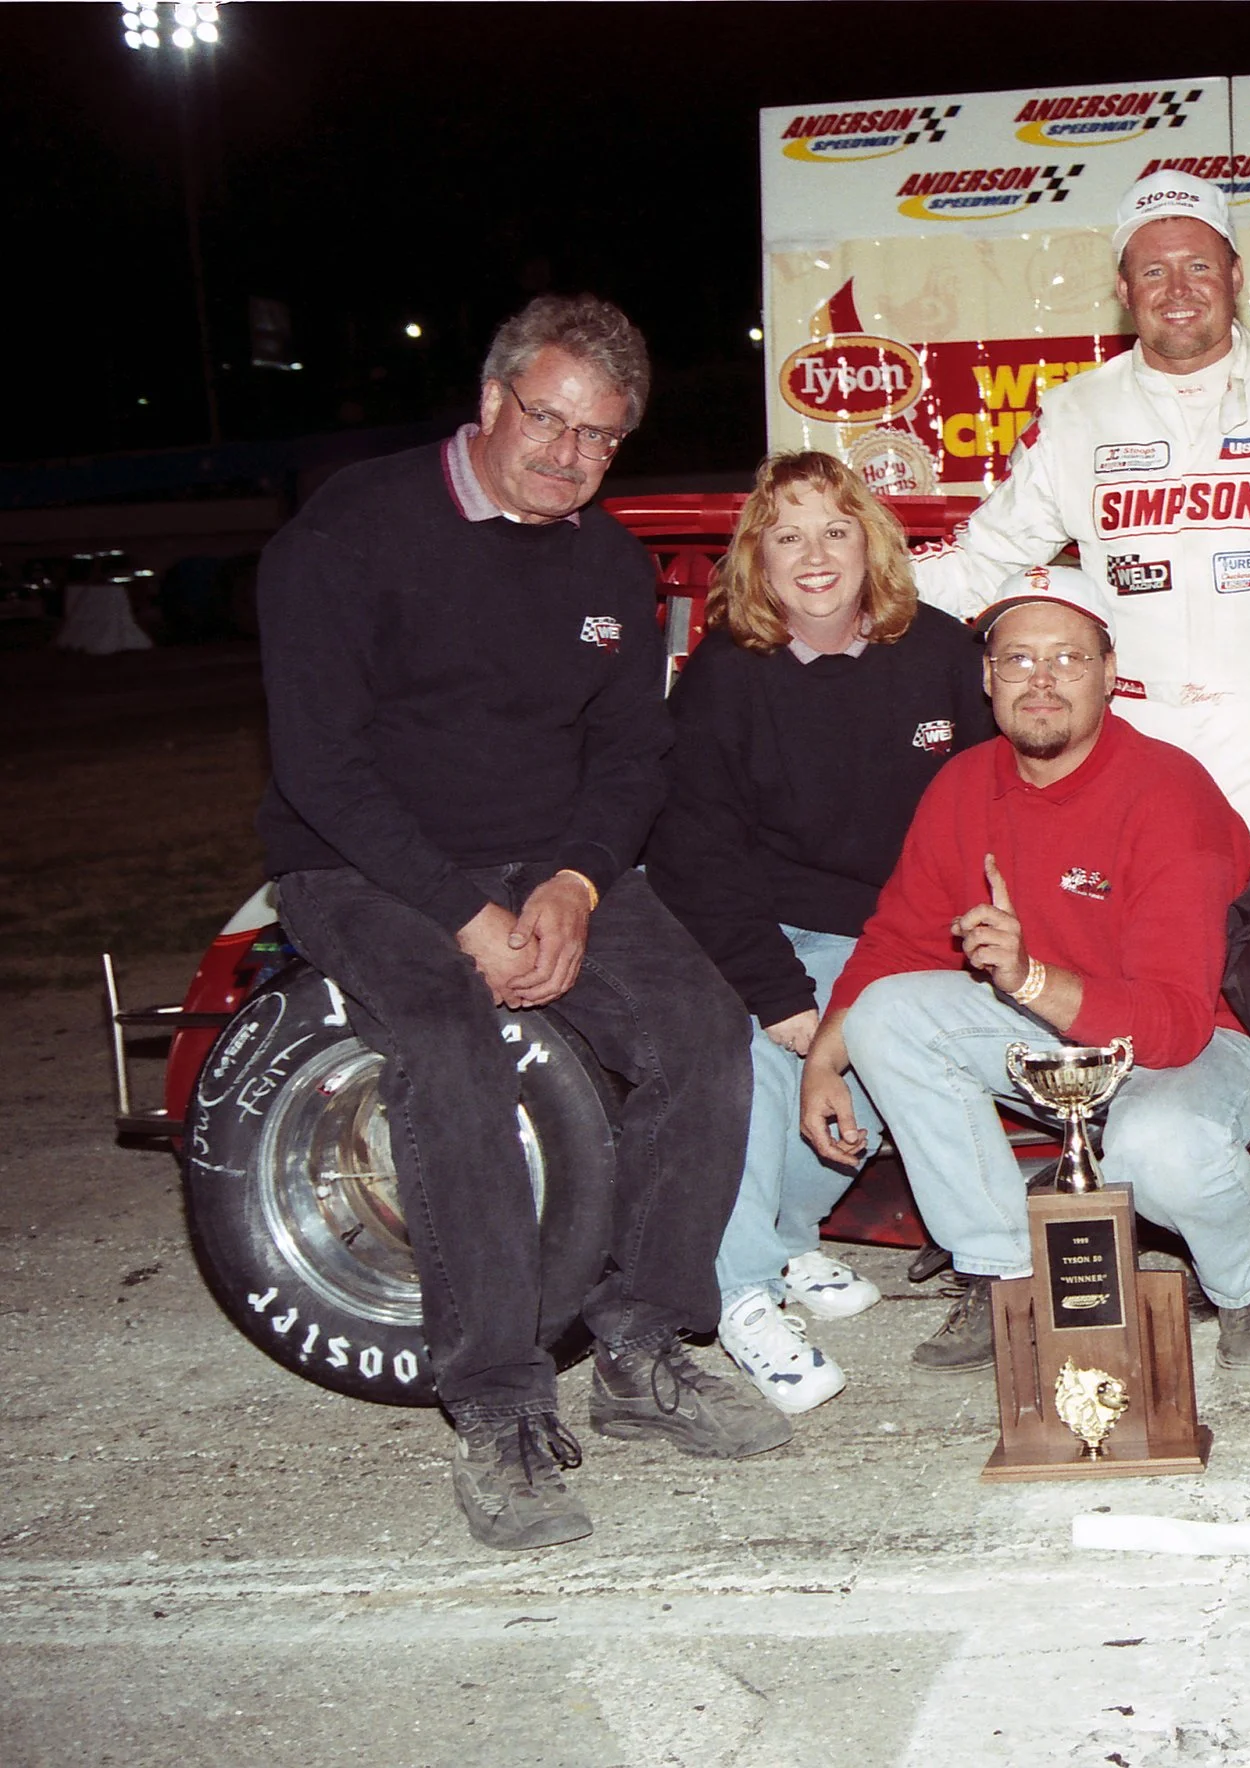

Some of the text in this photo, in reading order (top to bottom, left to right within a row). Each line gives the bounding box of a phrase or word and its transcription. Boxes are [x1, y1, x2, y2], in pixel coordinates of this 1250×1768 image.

[1014, 91, 1158, 123] ANDERSON
[781, 107, 918, 139] ANDERSON
[1046, 118, 1141, 137] SPEEDWAY
[811, 135, 900, 152] SPEEDWAY
[896, 166, 1041, 197] ANDERSON
[928, 193, 1023, 210] SPEEDWAY
[1135, 190, 1200, 210] Stoops
[795, 357, 908, 405] Tyson
[1117, 565, 1168, 586] WELD
[1062, 1256, 1090, 1265] TYSON
[247, 1286, 420, 1384] oosier
